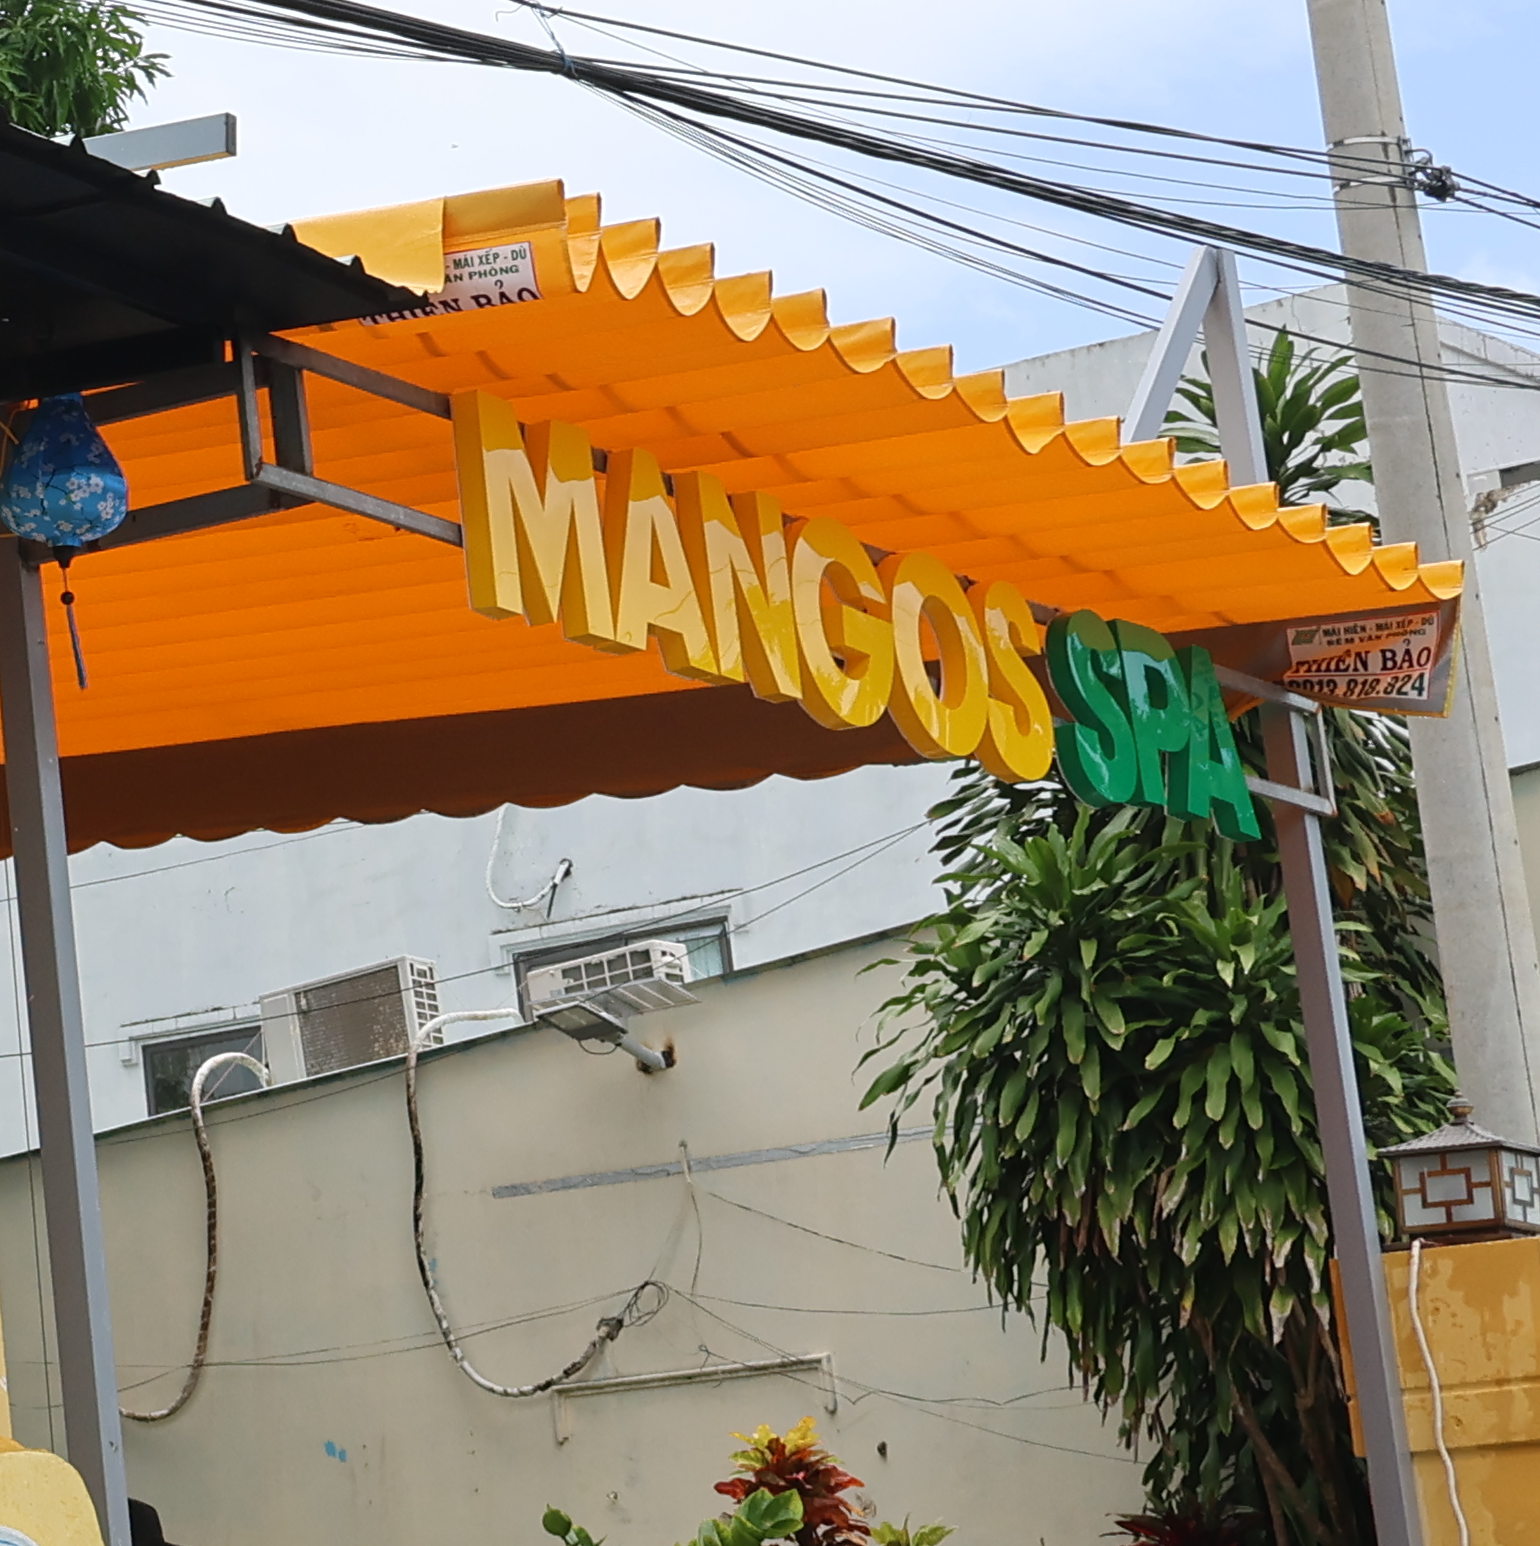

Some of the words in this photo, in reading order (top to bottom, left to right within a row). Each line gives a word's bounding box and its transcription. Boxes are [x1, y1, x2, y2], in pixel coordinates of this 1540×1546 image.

[478, 248, 500, 266] XẾP
[511, 247, 528, 261] DÙ
[468, 264, 520, 281] PHÒNG
[451, 388, 1055, 784] MANGOS
[1045, 609, 1262, 843] SPA
[1380, 638, 1432, 672] BẢO
